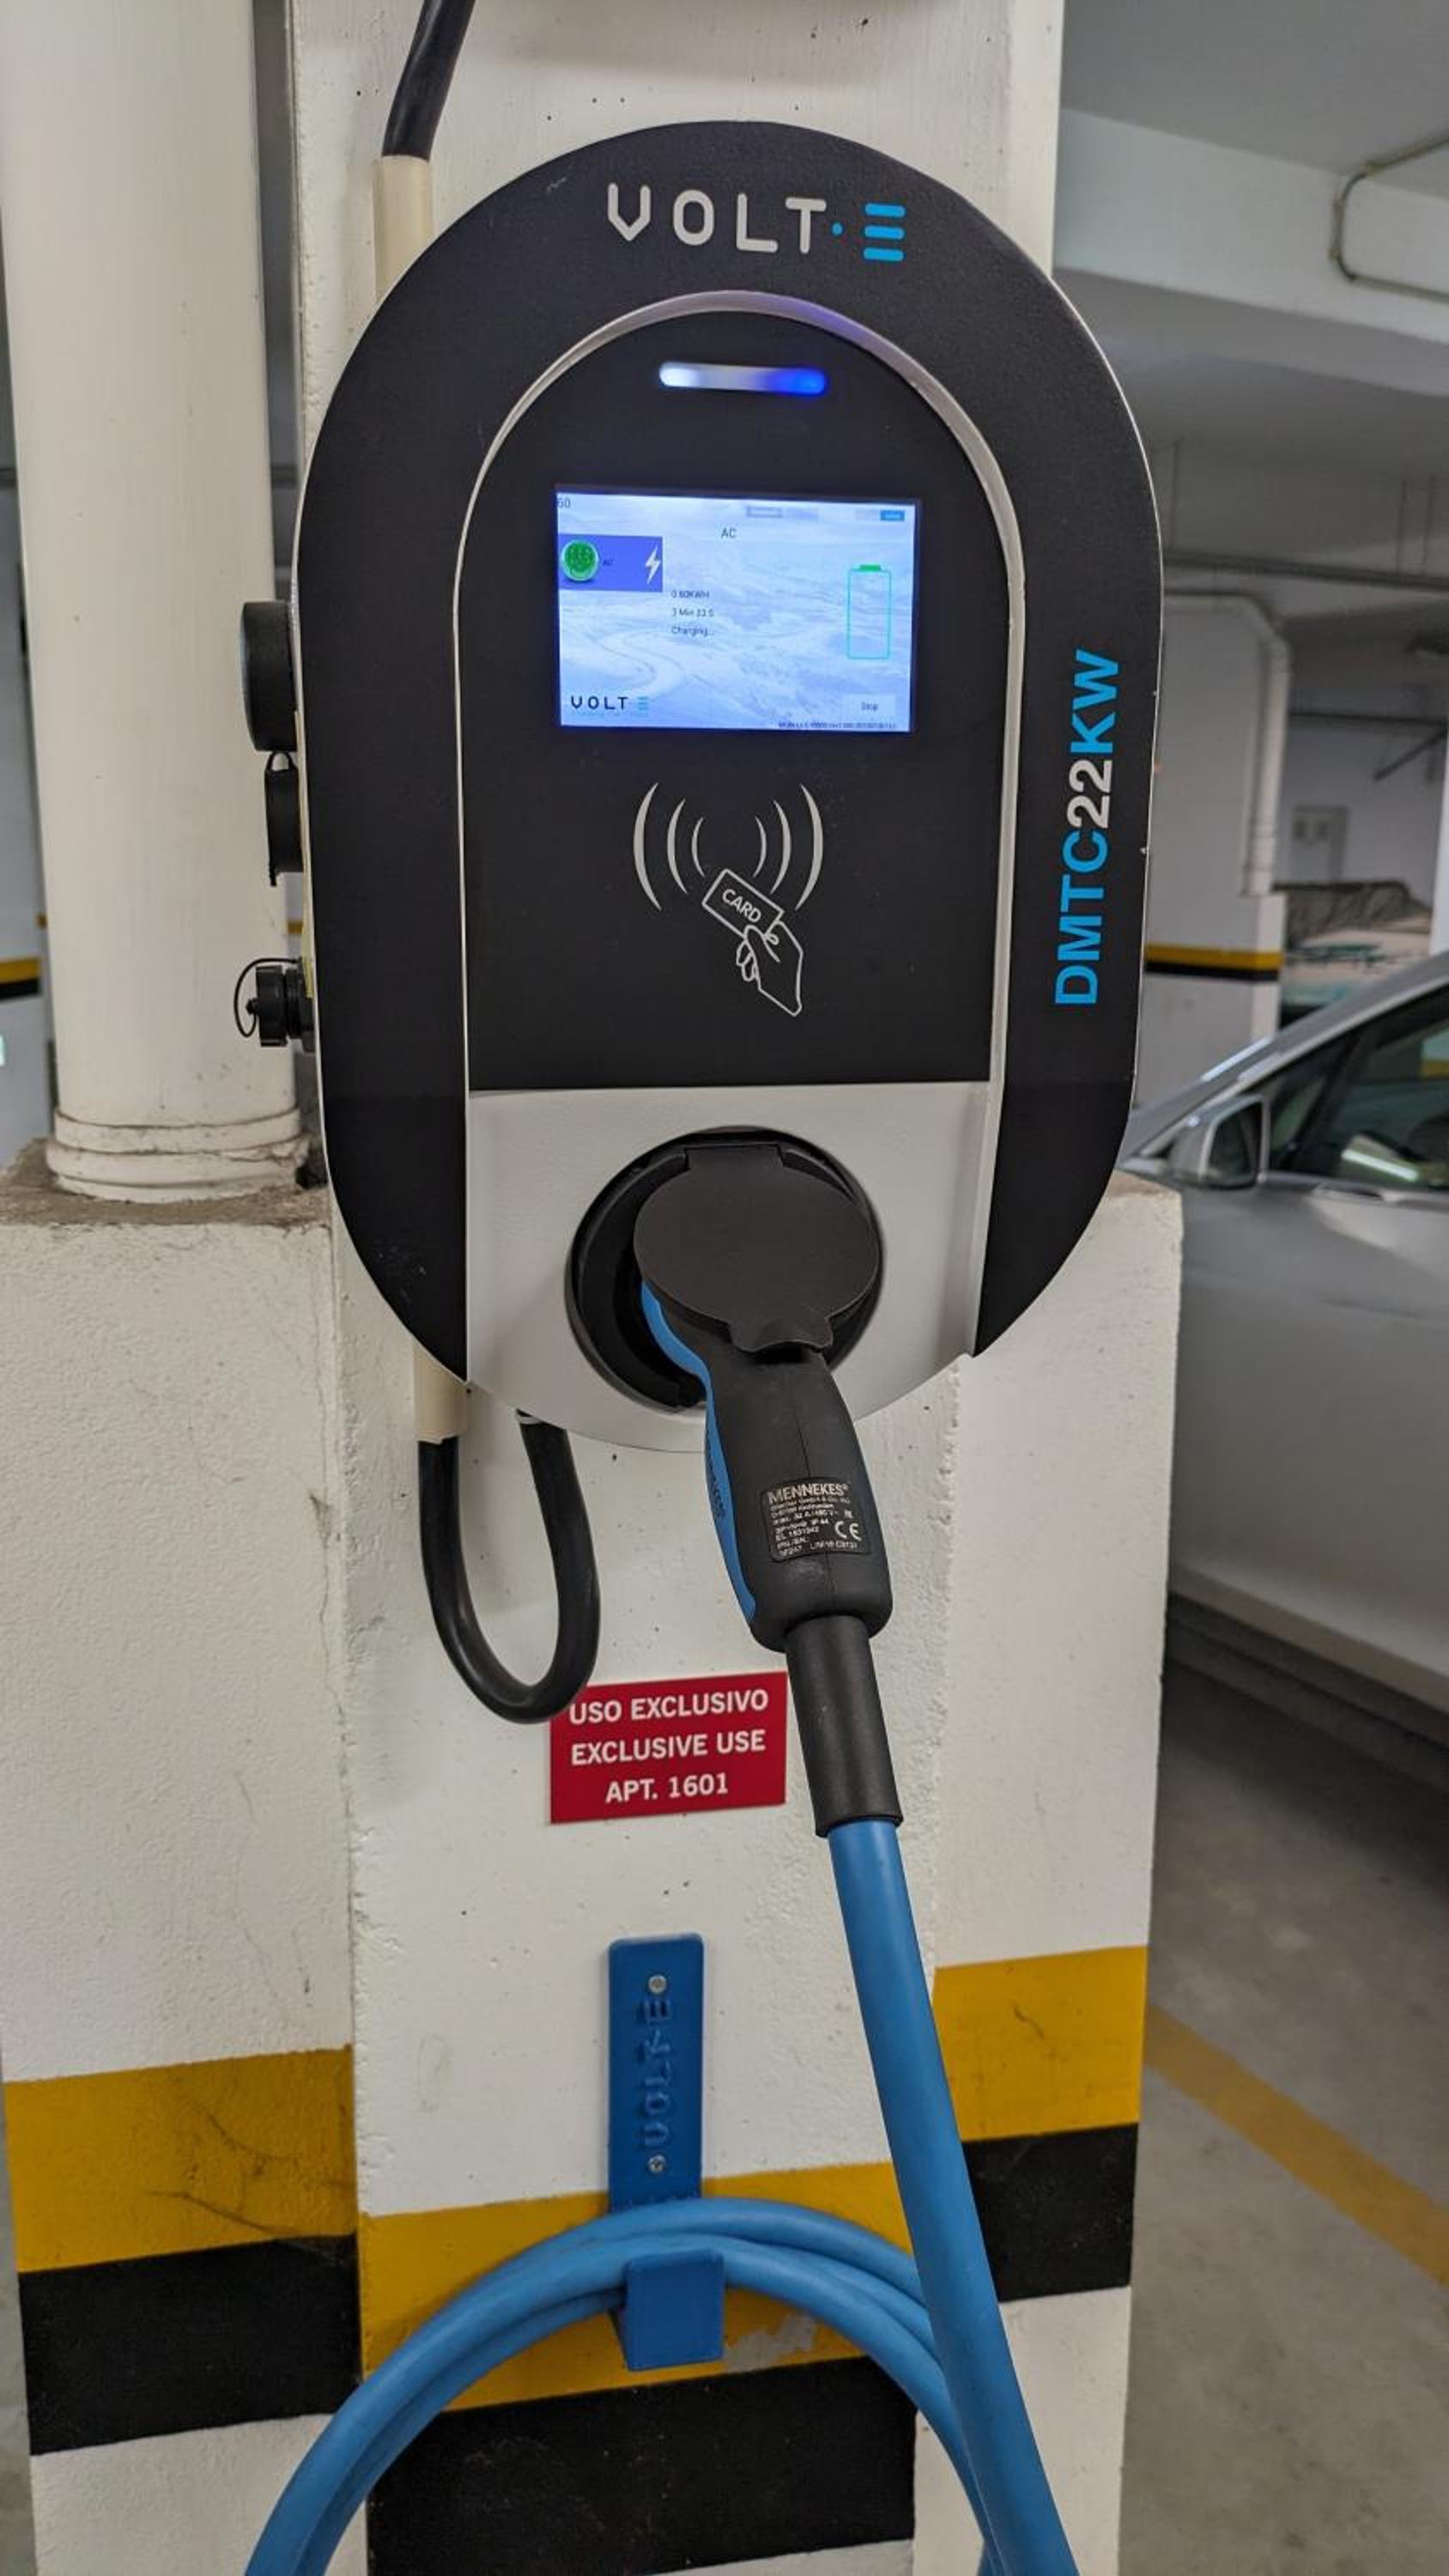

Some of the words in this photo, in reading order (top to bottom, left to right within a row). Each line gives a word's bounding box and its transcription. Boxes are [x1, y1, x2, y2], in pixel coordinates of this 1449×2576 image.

[720, 526, 737, 540] AC
[1055, 648, 1119, 1005] DMTC22KW
[721, 889, 762, 923] CARD
[569, 1700, 621, 1725] USO
[631, 1689, 768, 1720] EXCLUSIVO
[571, 1734, 708, 1765] EXCLUSIVE
[717, 1729, 766, 1753] USE
[605, 1778, 658, 1803] APT.
[669, 1772, 728, 1798] 1601
